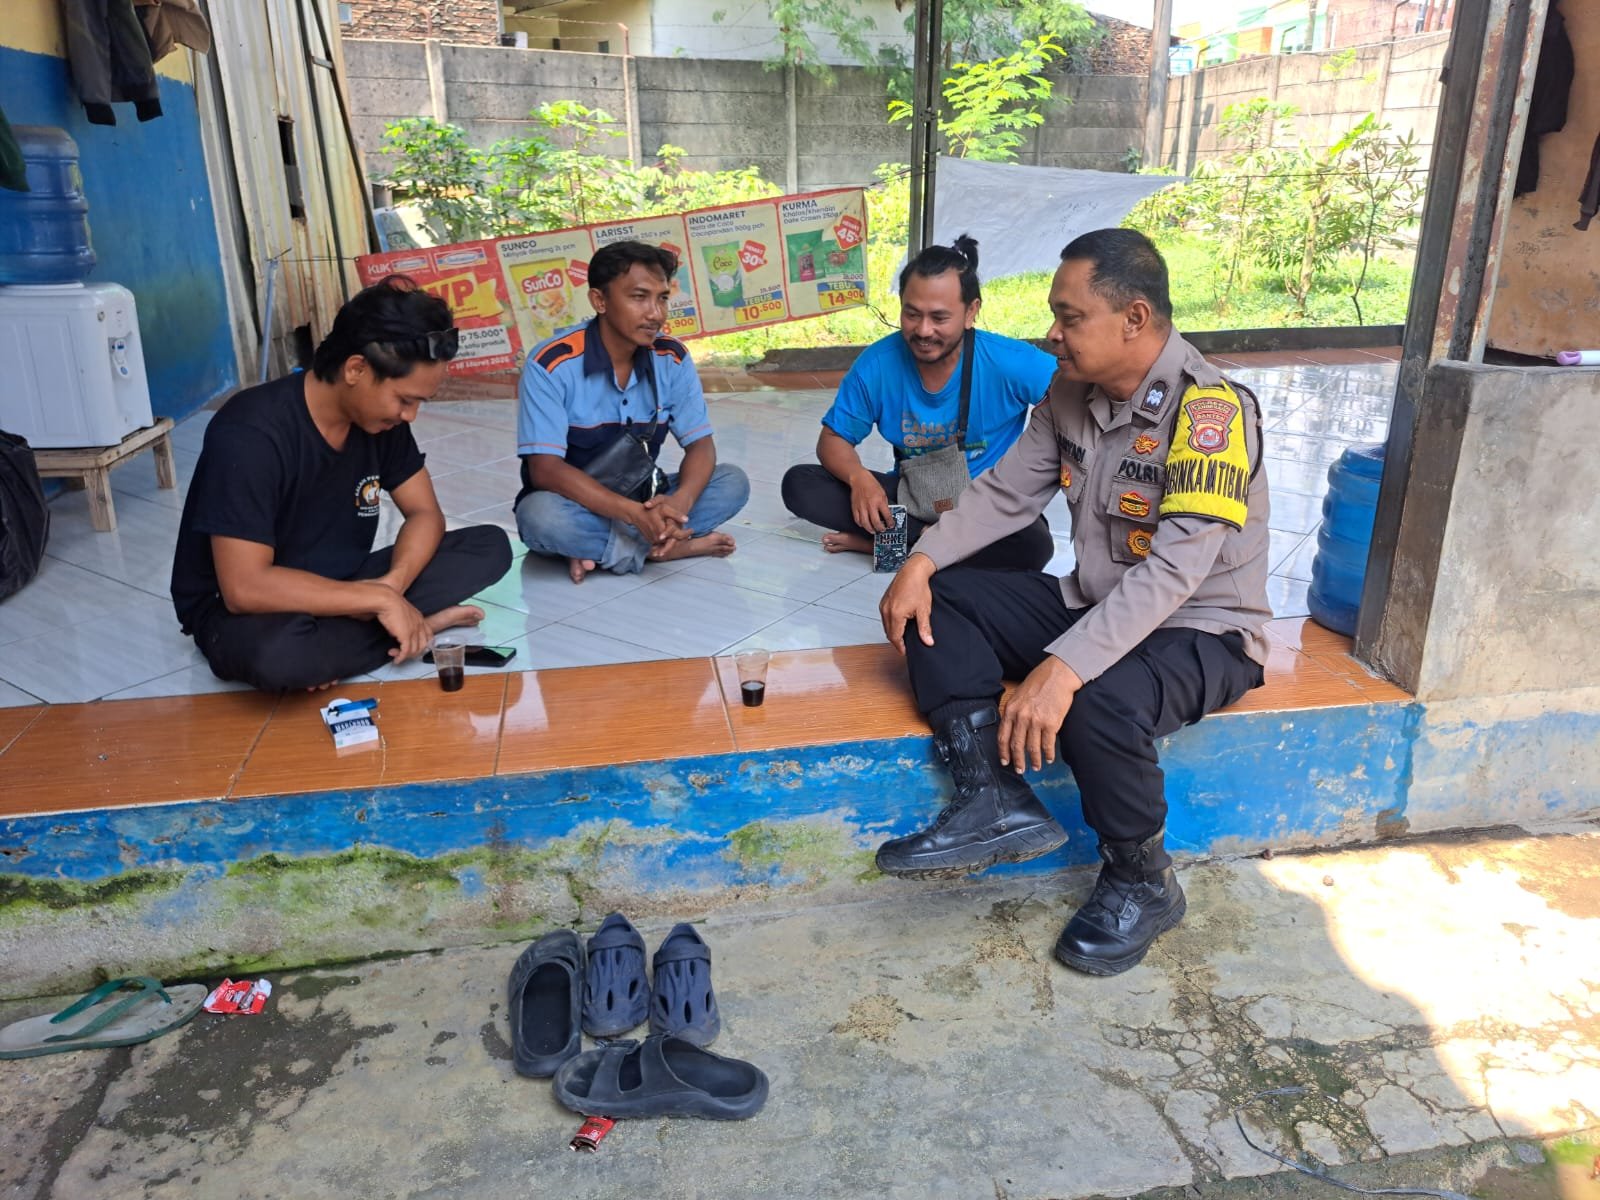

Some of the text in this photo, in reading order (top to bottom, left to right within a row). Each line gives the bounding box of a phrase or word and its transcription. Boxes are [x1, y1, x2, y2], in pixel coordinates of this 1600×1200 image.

[782, 199, 818, 211] KURMA
[688, 210, 747, 225] INDOMARET
[595, 225, 634, 238] LARISST
[500, 240, 537, 252] SUNCO
[522, 271, 562, 293] SunCo
[742, 301, 782, 321] 10.500
[1118, 459, 1159, 482] POLRI
